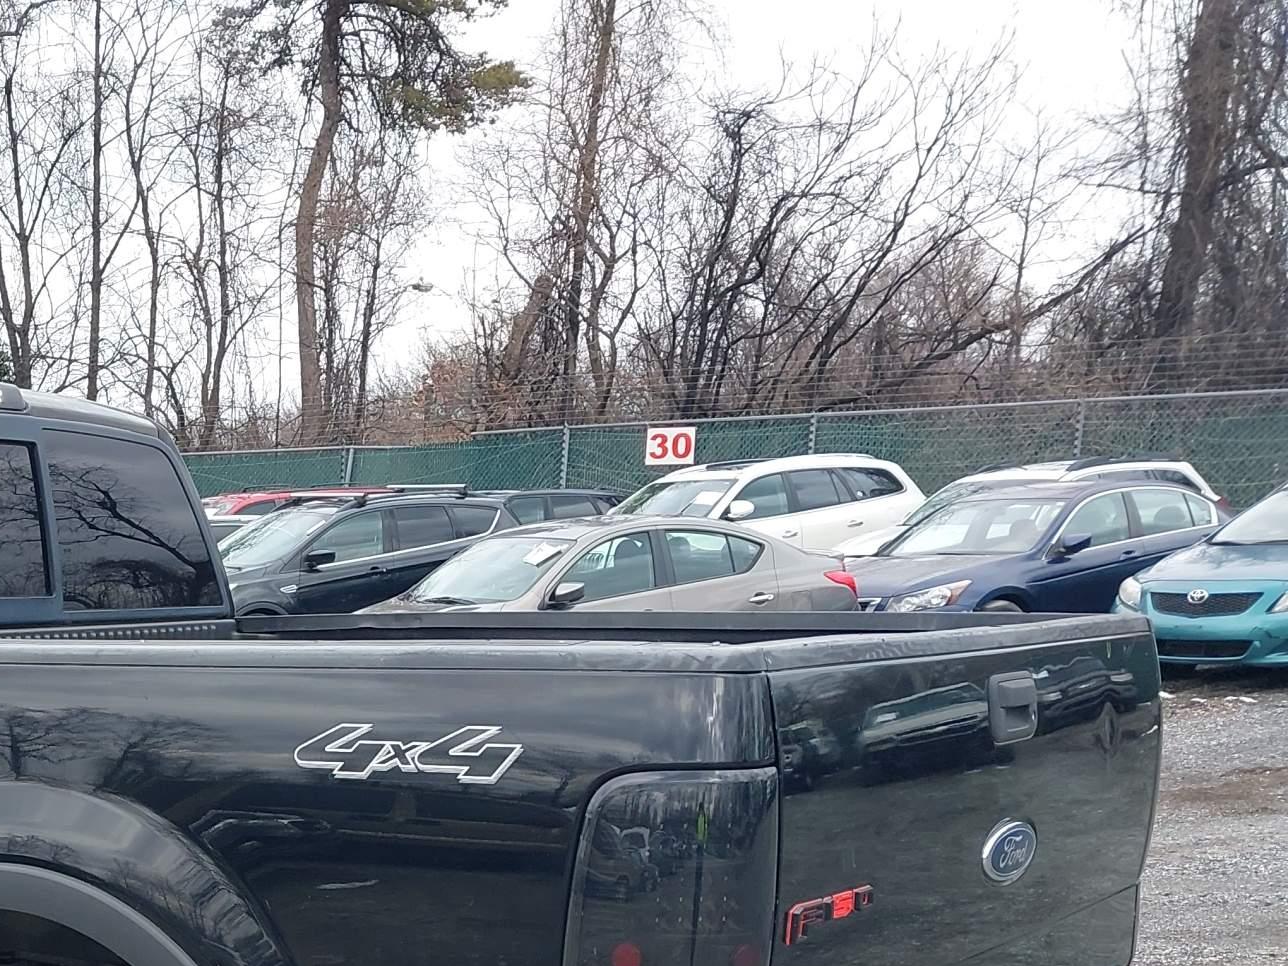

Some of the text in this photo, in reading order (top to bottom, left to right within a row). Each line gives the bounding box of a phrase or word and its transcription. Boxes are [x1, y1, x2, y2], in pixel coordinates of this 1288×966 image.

[649, 432, 692, 459] 30
[294, 723, 524, 784] 4x4
[999, 834, 1030, 868] Ford
